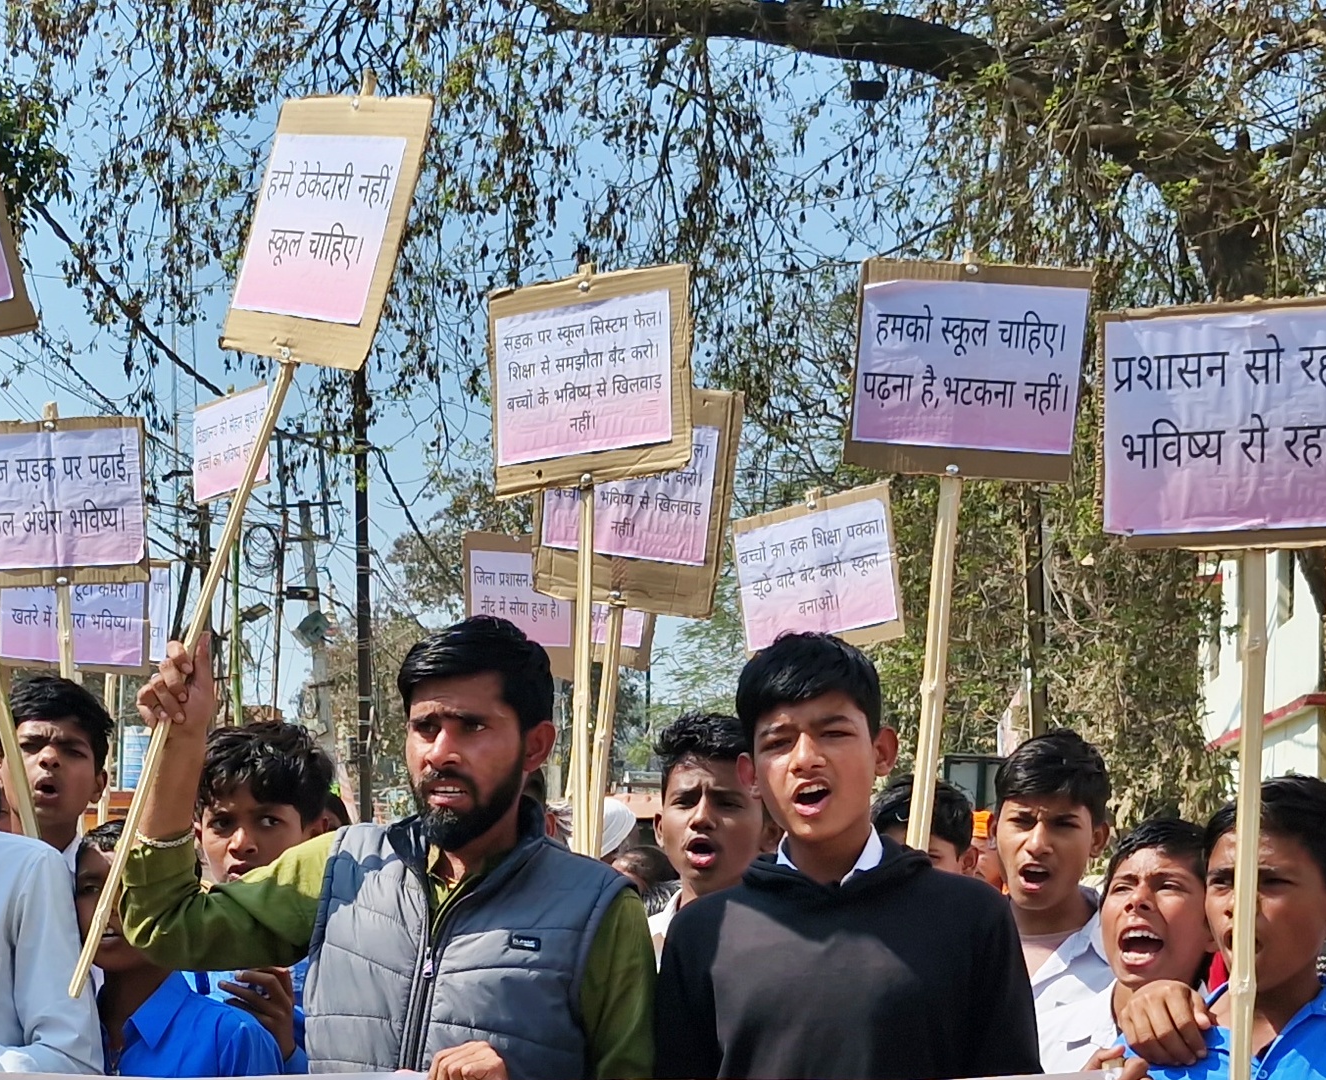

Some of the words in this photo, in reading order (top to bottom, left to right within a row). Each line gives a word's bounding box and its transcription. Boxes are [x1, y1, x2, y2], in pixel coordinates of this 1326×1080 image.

[267, 160, 296, 200] हमें
[296, 161, 354, 200] ठेकेदारी
[268, 229, 305, 266] स्कूल
[309, 222, 364, 270] चाहिए।
[504, 333, 533, 353] सड़क
[538, 329, 552, 344] पर
[558, 324, 584, 346] स्कूल
[590, 315, 627, 336] सिस्टम
[634, 309, 662, 328] फेल।
[876, 305, 933, 345] हमको
[941, 317, 990, 356] स्कूल
[998, 311, 1066, 358] चाहिए।
[508, 361, 535, 382] शिक्षा
[541, 355, 550, 375] से
[555, 349, 603, 373] समझौता
[608, 342, 625, 367] बंद
[631, 339, 659, 360] करो।
[1112, 351, 1229, 392] प्रशासन
[1243, 335, 1284, 385] सो
[507, 389, 533, 412] बच्चों
[537, 387, 549, 406] के
[554, 383, 590, 404] भविष्य
[596, 377, 607, 397] से
[612, 374, 662, 395] खिलवाड़
[863, 372, 914, 409] पढ़ना
[1024, 373, 1068, 415] नहीं।
[570, 411, 596, 433] नहीं।
[1122, 418, 1224, 470] भविष्य
[1240, 414, 1269, 464] रो
[16, 457, 56, 489] सड़क
[62, 456, 82, 480] पर
[23, 501, 62, 535] अंधेरा
[70, 499, 125, 533] भविष्य।
[474, 566, 495, 586] जिला
